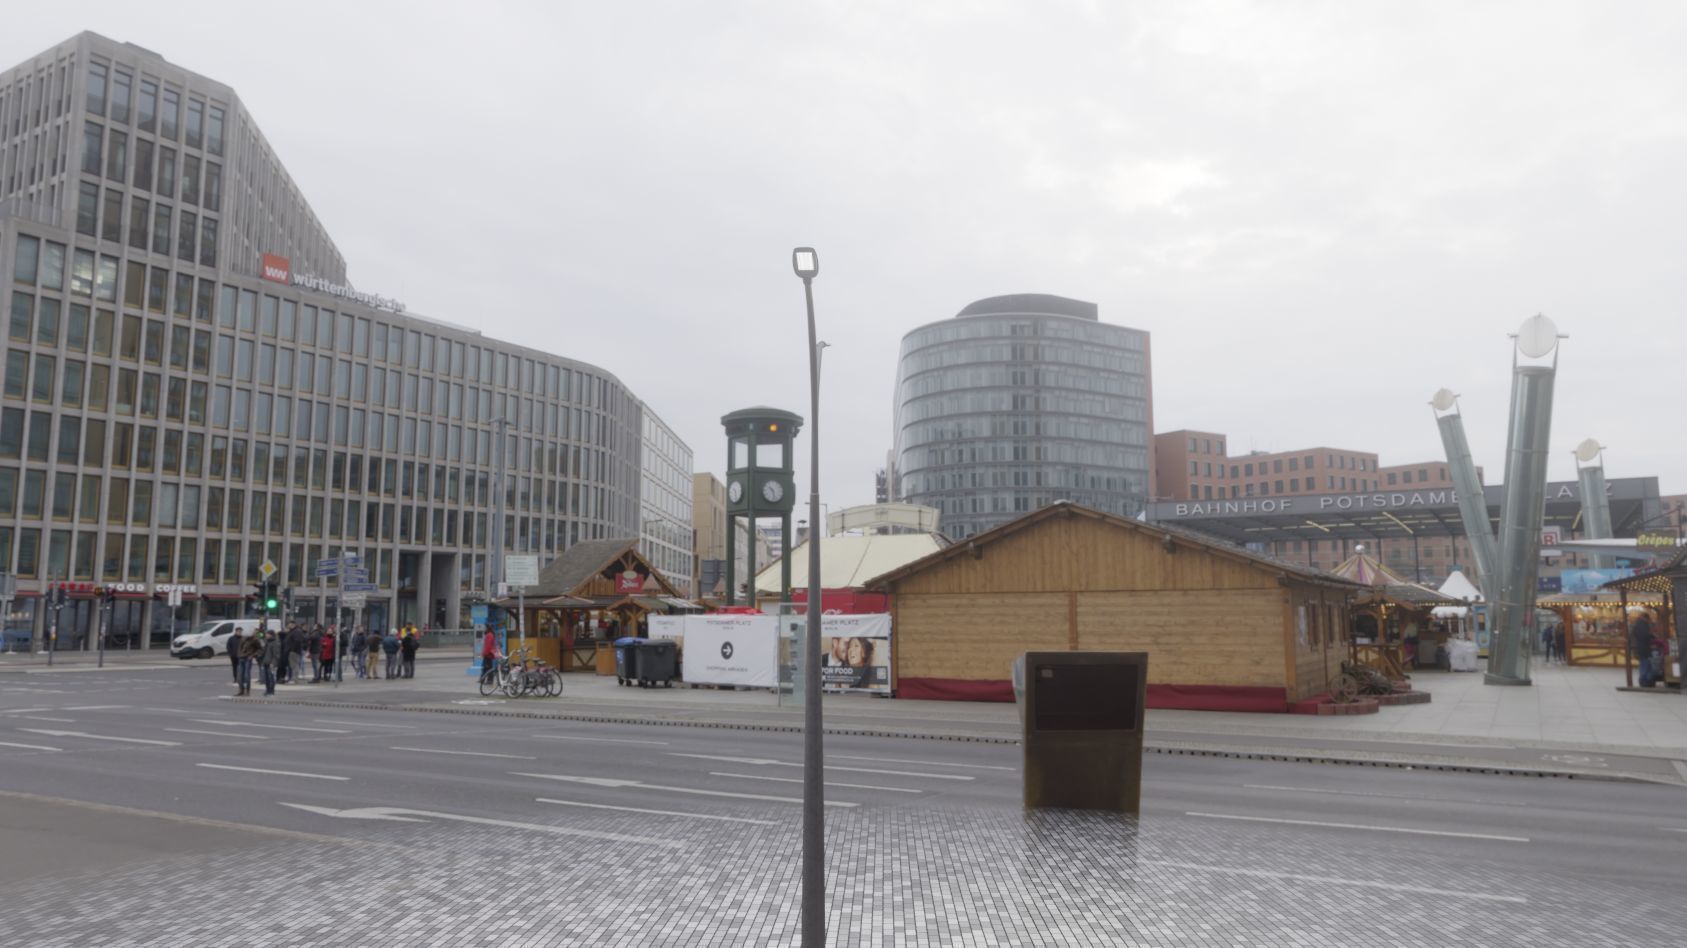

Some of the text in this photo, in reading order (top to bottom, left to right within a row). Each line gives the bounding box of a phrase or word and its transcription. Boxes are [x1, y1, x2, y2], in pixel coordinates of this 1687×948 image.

[1175, 500, 1293, 516] BAHNHOF
[155, 583, 197, 593] COFFEE
[835, 667, 854, 675] FOOD
